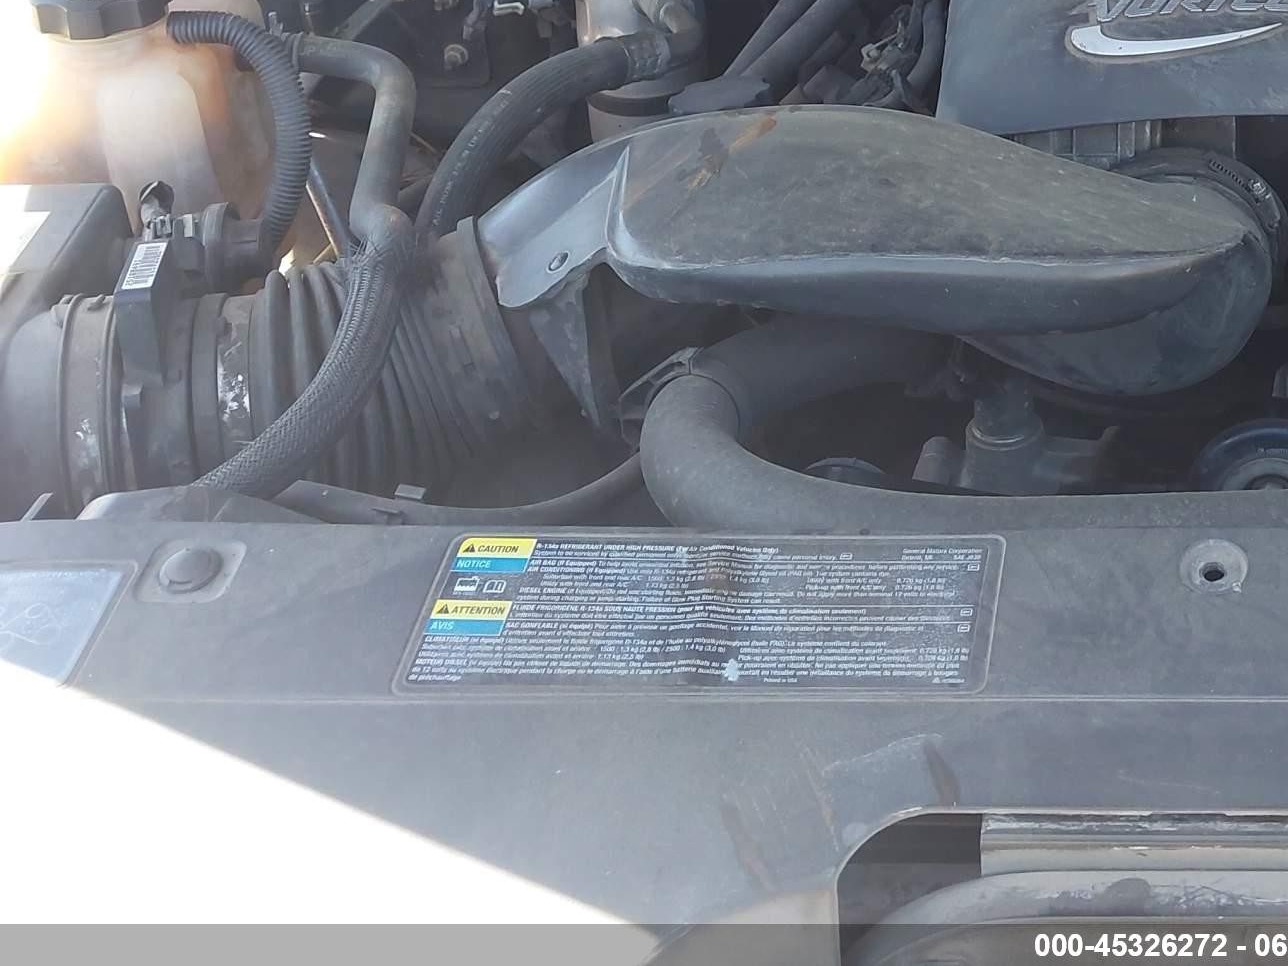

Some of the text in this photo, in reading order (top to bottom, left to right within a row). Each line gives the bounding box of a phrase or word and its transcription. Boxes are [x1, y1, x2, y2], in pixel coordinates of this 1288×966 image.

[477, 545, 519, 553] CAUTION
[456, 560, 491, 568] NOTICE
[452, 606, 506, 615] ATTENTION
[430, 621, 455, 630] AVIS
